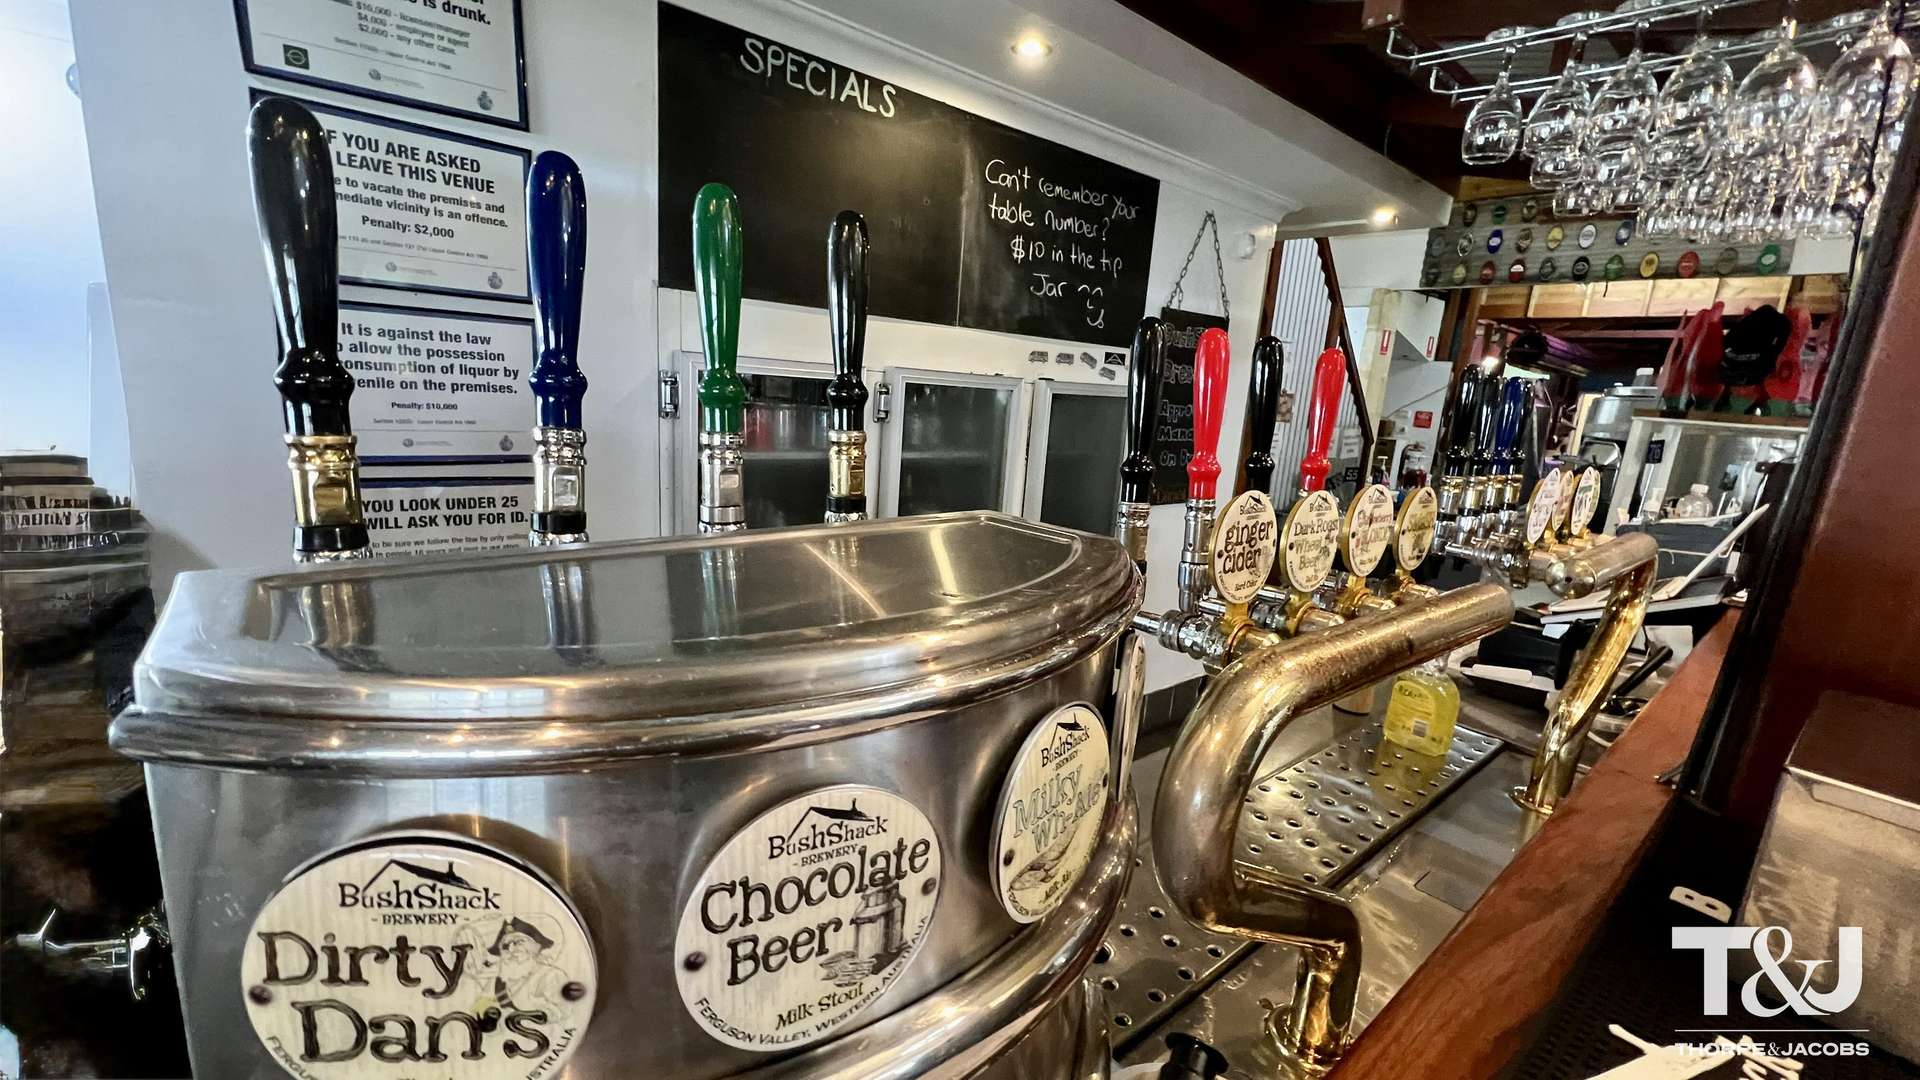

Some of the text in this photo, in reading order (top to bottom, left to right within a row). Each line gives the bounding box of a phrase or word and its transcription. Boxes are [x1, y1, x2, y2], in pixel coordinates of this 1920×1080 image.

[423, 0, 491, 25] is drunk.
[740, 38, 896, 118] SPECIALS
[326, 129, 481, 173] F YOU ARE ASKED
[336, 151, 495, 194] LEAVE THIS VENUE
[985, 159, 1031, 192] Can't
[1038, 177, 1110, 206] remember
[346, 176, 359, 188] to
[362, 180, 404, 196] vacate
[407, 187, 426, 200] the
[430, 192, 482, 210] premises
[485, 202, 505, 214] and
[988, 192, 1035, 227] table
[361, 215, 454, 239] Penalty: $2,000
[386, 199, 430, 217] vicinity
[434, 205, 444, 217] is
[447, 210, 462, 221] an
[465, 212, 508, 228] offence.
[1010, 235, 1122, 279] $10 in the tip
[1030, 272, 1068, 297] Jar
[341, 322, 492, 346] It is against the law
[349, 341, 392, 355] allow
[397, 344, 421, 357] the
[426, 347, 505, 362] possession
[356, 377, 518, 395] enile on the premises.
[440, 362, 455, 374] of
[459, 365, 500, 379] liquor
[503, 366, 519, 380] by
[391, 401, 458, 412] Penalty: $10,000
[362, 496, 519, 513] YOU LOOK UNDER 25
[363, 511, 528, 530] WILL ASK YOU FOR ID.
[1224, 519, 1274, 553] ginger
[1222, 546, 1262, 575] cider
[768, 816, 888, 860] BushShack
[338, 881, 500, 910] BushShack
[700, 837, 931, 934] Chocolate
[382, 914, 459, 926] BREWERY
[257, 931, 473, 999] Dirty
[727, 916, 843, 986] Beer
[694, 997, 756, 1043] FERGUSON
[815, 987, 880, 1033] WESTERN
[775, 982, 864, 1031] Milk Stout
[291, 998, 551, 1063] Dan's
